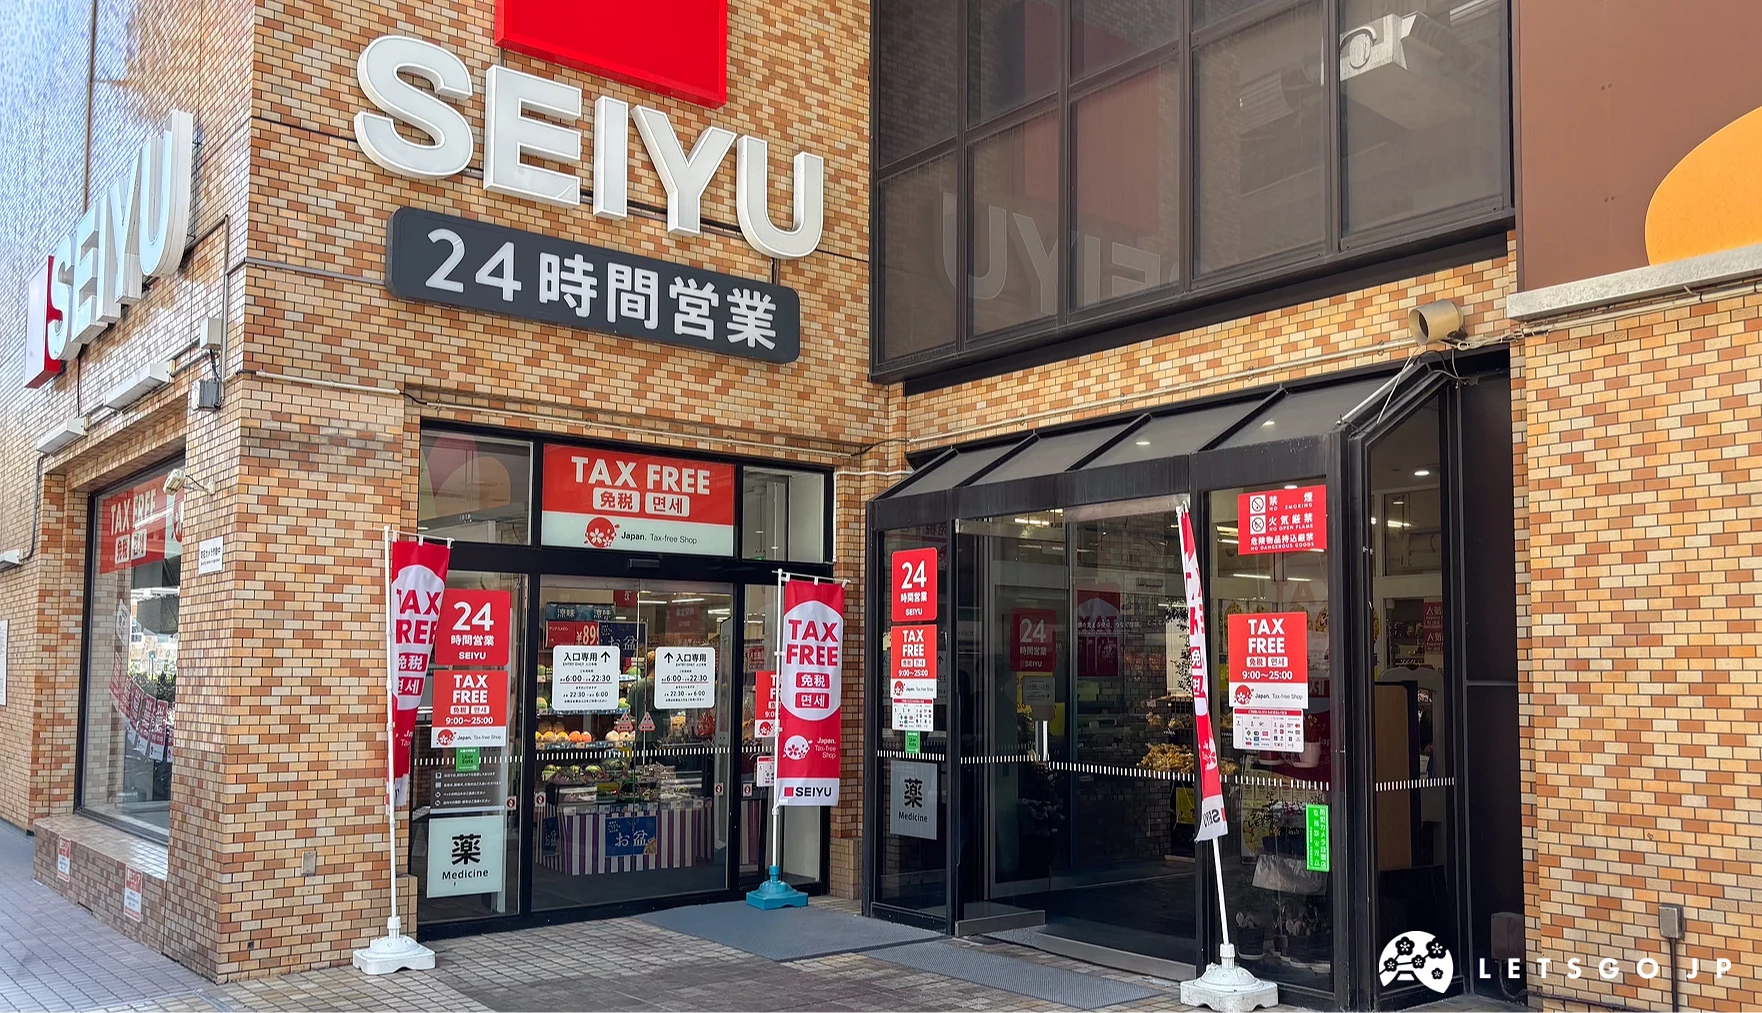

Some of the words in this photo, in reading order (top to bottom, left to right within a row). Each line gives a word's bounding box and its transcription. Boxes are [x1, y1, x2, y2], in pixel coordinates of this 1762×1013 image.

[354, 35, 824, 260] SEIYU
[48, 109, 193, 360] SEIYU
[425, 228, 777, 351] 24時間営業
[571, 456, 638, 488] TAX
[646, 464, 711, 495] FREE
[599, 490, 634, 511] 免税
[652, 494, 684, 515] 면세
[1285, 502, 1313, 511] SMOKING
[110, 498, 131, 536] TAX
[621, 531, 647, 543] Japan.
[649, 533, 678, 543] Tax-free
[680, 535, 698, 545] Shop
[1260, 543, 1293, 551] DANGEROUS
[901, 560, 927, 590] 24
[900, 592, 928, 603] 時間営業
[452, 601, 495, 632] 24
[905, 607, 922, 616] SEIYU
[788, 619, 839, 643] TAX
[1020, 618, 1047, 644] 24
[1247, 618, 1285, 635] TAX
[450, 635, 495, 647] 時間営業
[902, 629, 924, 642] TAX
[902, 644, 924, 657] FREE
[1019, 645, 1047, 657] 時間営業
[1247, 637, 1285, 654] FREE
[458, 651, 487, 660] SEIYU
[563, 652, 598, 662] 入口専用
[676, 653, 707, 663] 入口専用
[786, 643, 839, 667] FREE
[1025, 660, 1043, 668] SEIYU
[1249, 658, 1263, 666] 免税
[454, 674, 488, 688] TAX
[566, 674, 582, 682] 6:00
[591, 674, 611, 682] 22:30
[667, 674, 681, 682] 6:00
[690, 674, 707, 682] 22:30
[801, 674, 825, 687] 免税
[398, 679, 419, 695] 세
[452, 690, 488, 704] FREE
[801, 695, 825, 707] 면세
[1291, 693, 1302, 701] Shop
[457, 734, 472, 742] Japan.
[817, 737, 836, 746] Japan.
[815, 744, 836, 752] Tax-free
[822, 752, 836, 760] Shop
[795, 786, 832, 797] SEIYU
[904, 778, 922, 808] 薬
[898, 811, 928, 823] Medicine
[615, 829, 648, 848] お盆
[451, 833, 482, 866] 薬
[442, 868, 489, 881] Medicine
